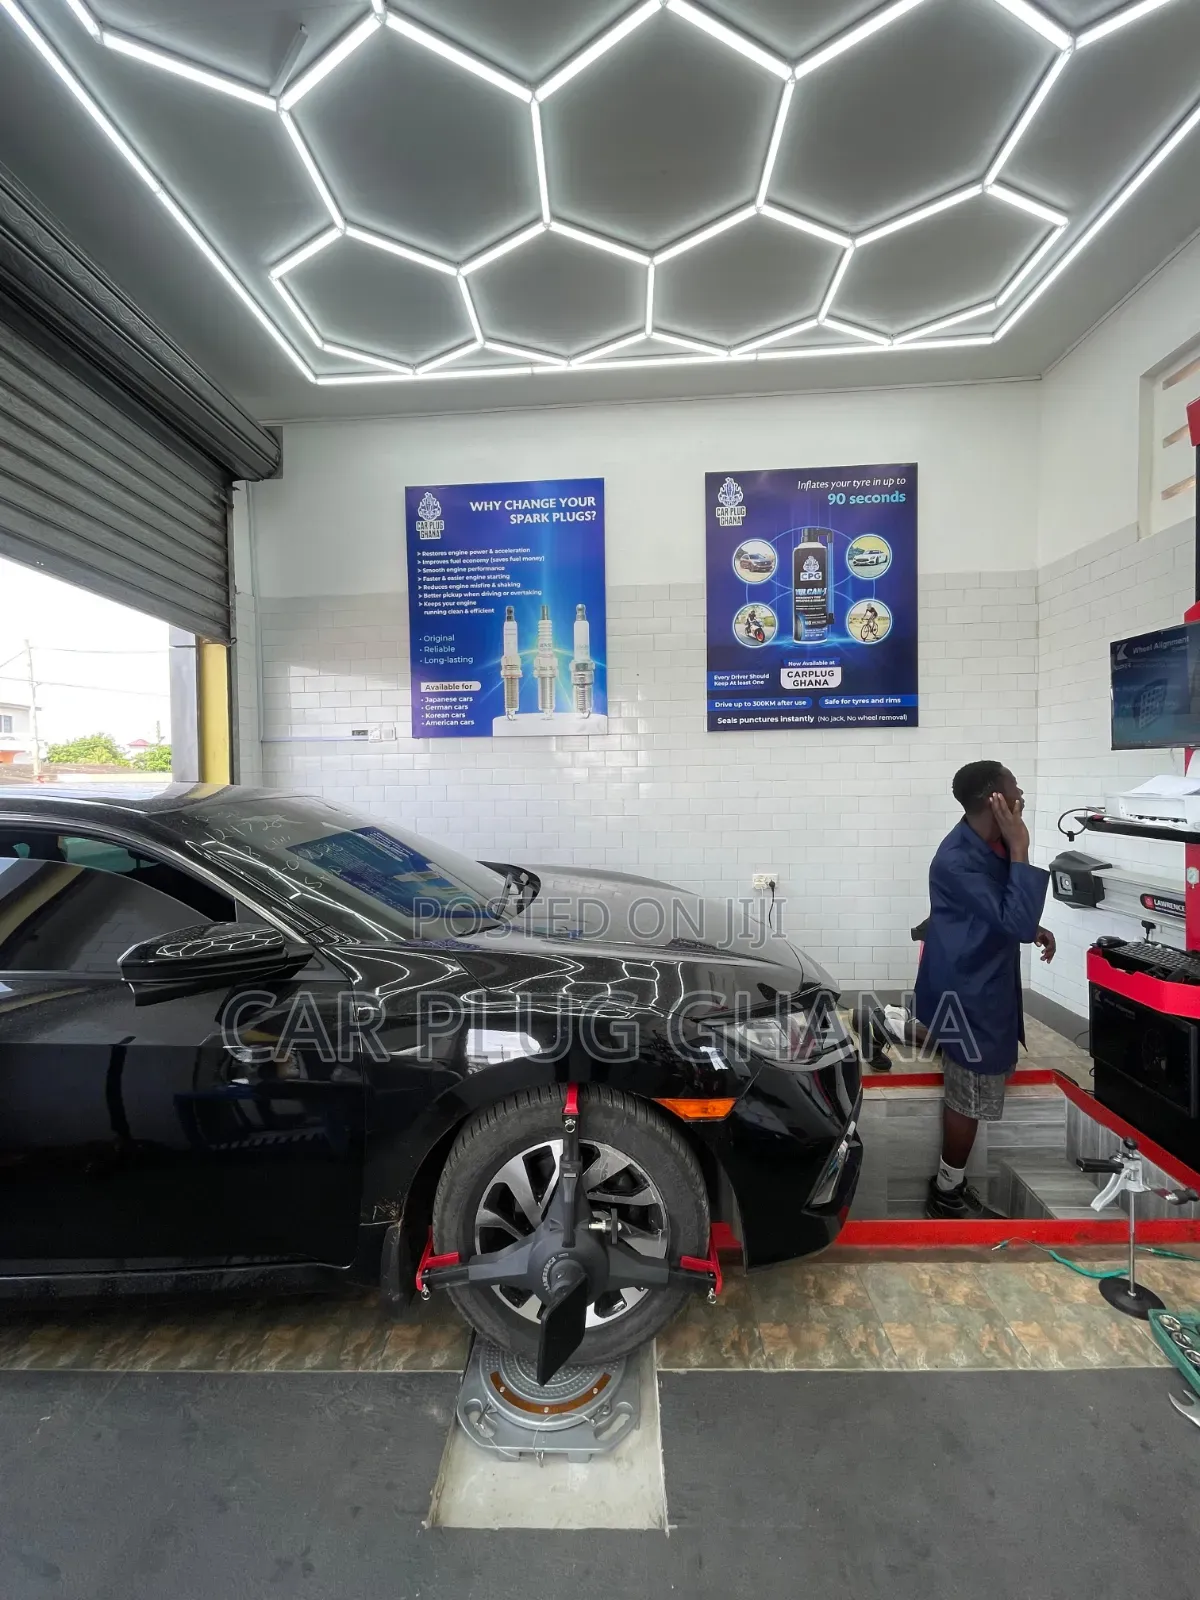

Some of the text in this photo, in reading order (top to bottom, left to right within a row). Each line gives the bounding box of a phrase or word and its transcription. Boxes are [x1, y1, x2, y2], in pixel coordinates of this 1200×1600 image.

[797, 480, 829, 490] Inflates
[830, 480, 851, 490] your
[853, 479, 870, 489] tyre
[883, 478, 895, 488] up
[828, 491, 906, 505] 90 seconds
[470, 497, 596, 512] WHY CHANGE YOUR
[717, 507, 745, 516] CAR PLUG
[510, 511, 596, 524] SPARK PLUGS?
[720, 516, 742, 525] GHANA
[417, 521, 443, 530] CAR PLUG
[420, 530, 441, 538] GHANA
[424, 634, 455, 643] Original
[1133, 645, 1152, 654] Wheel
[1154, 636, 1189, 649] Alignment
[424, 656, 474, 665] Long-lasting
[787, 670, 834, 678] CARPLUG
[793, 679, 829, 687] GHANA
[739, 716, 779, 724] punctures
[780, 715, 814, 724] instantly
[1154, 899, 1185, 911] LAWRENCE
